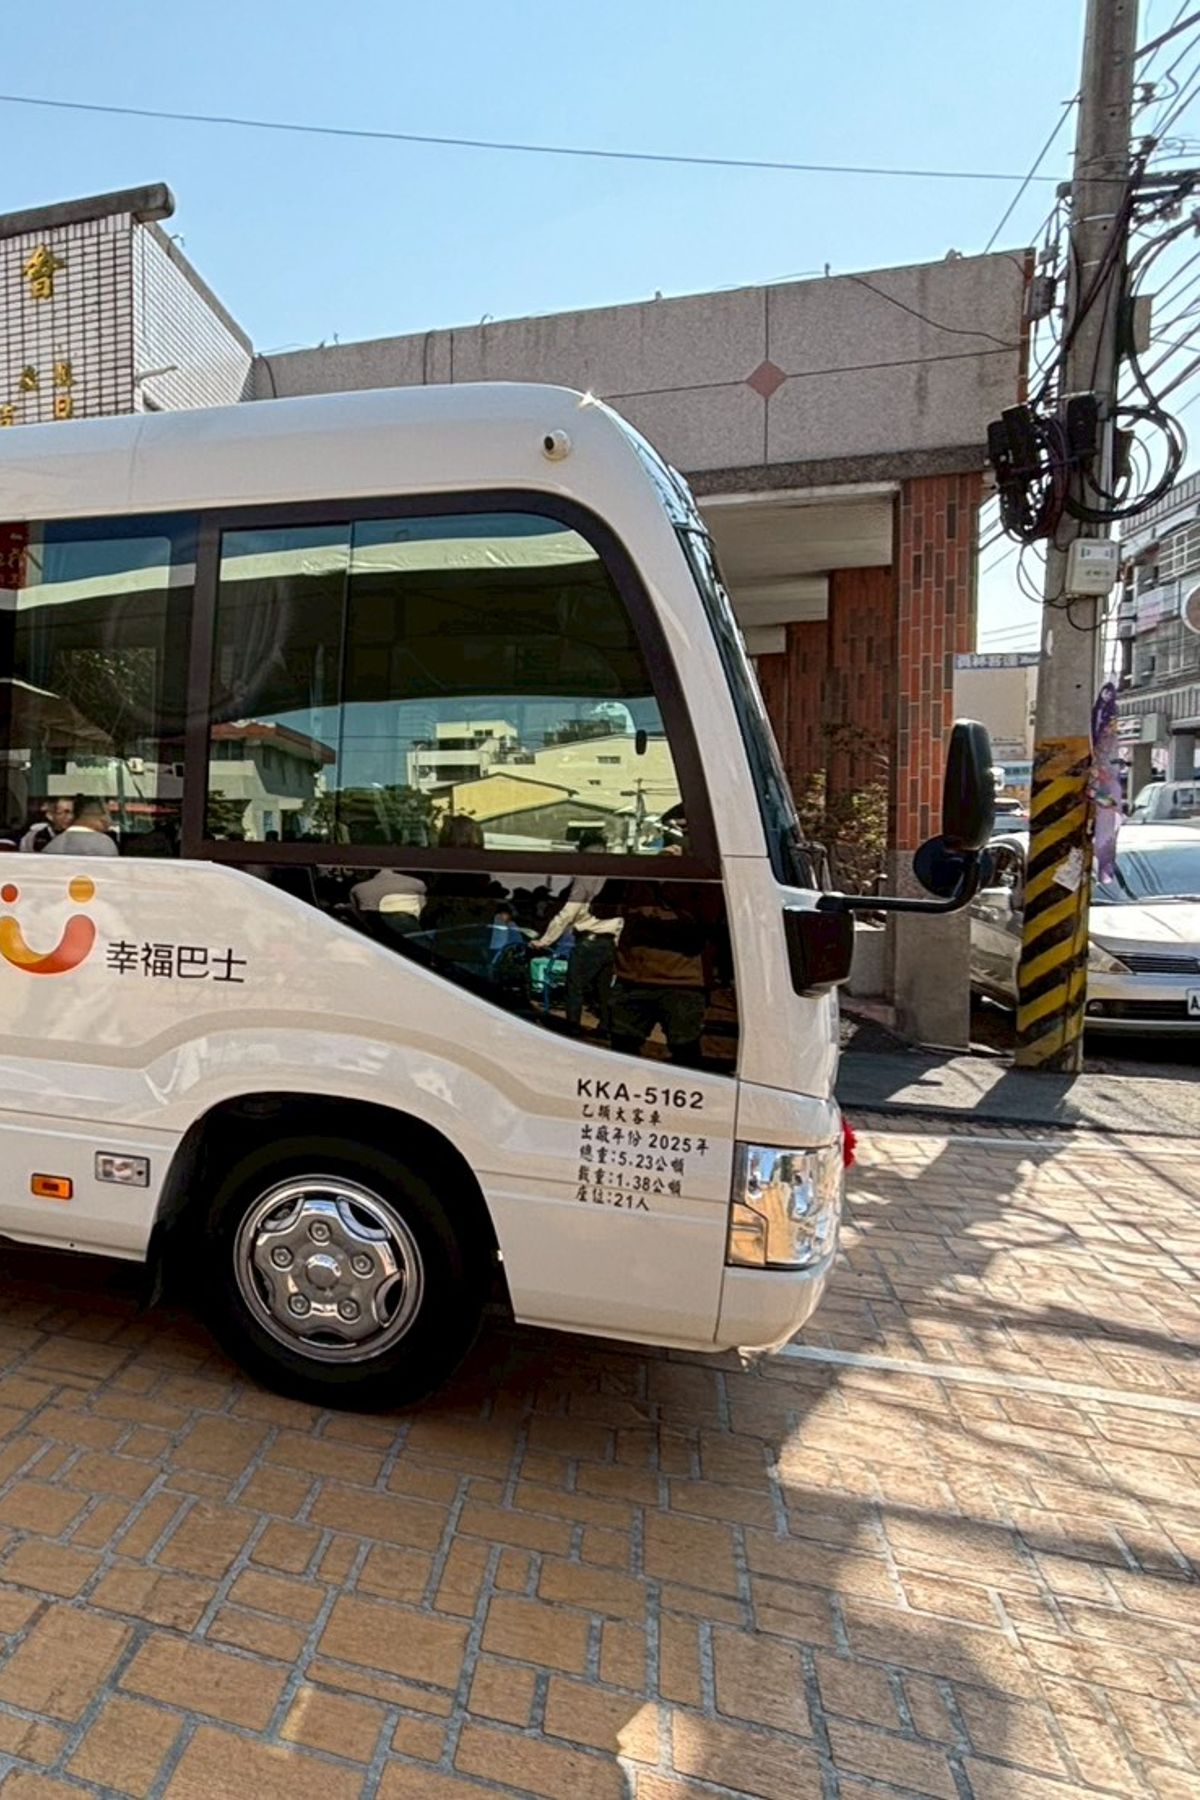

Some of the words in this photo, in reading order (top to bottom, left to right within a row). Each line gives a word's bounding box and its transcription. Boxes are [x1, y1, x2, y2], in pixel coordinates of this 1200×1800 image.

[106, 940, 249, 984] 幸福巴士
[577, 1078, 705, 1110] KKA-5162
[581, 1104, 663, 1126] 乙類大客車
